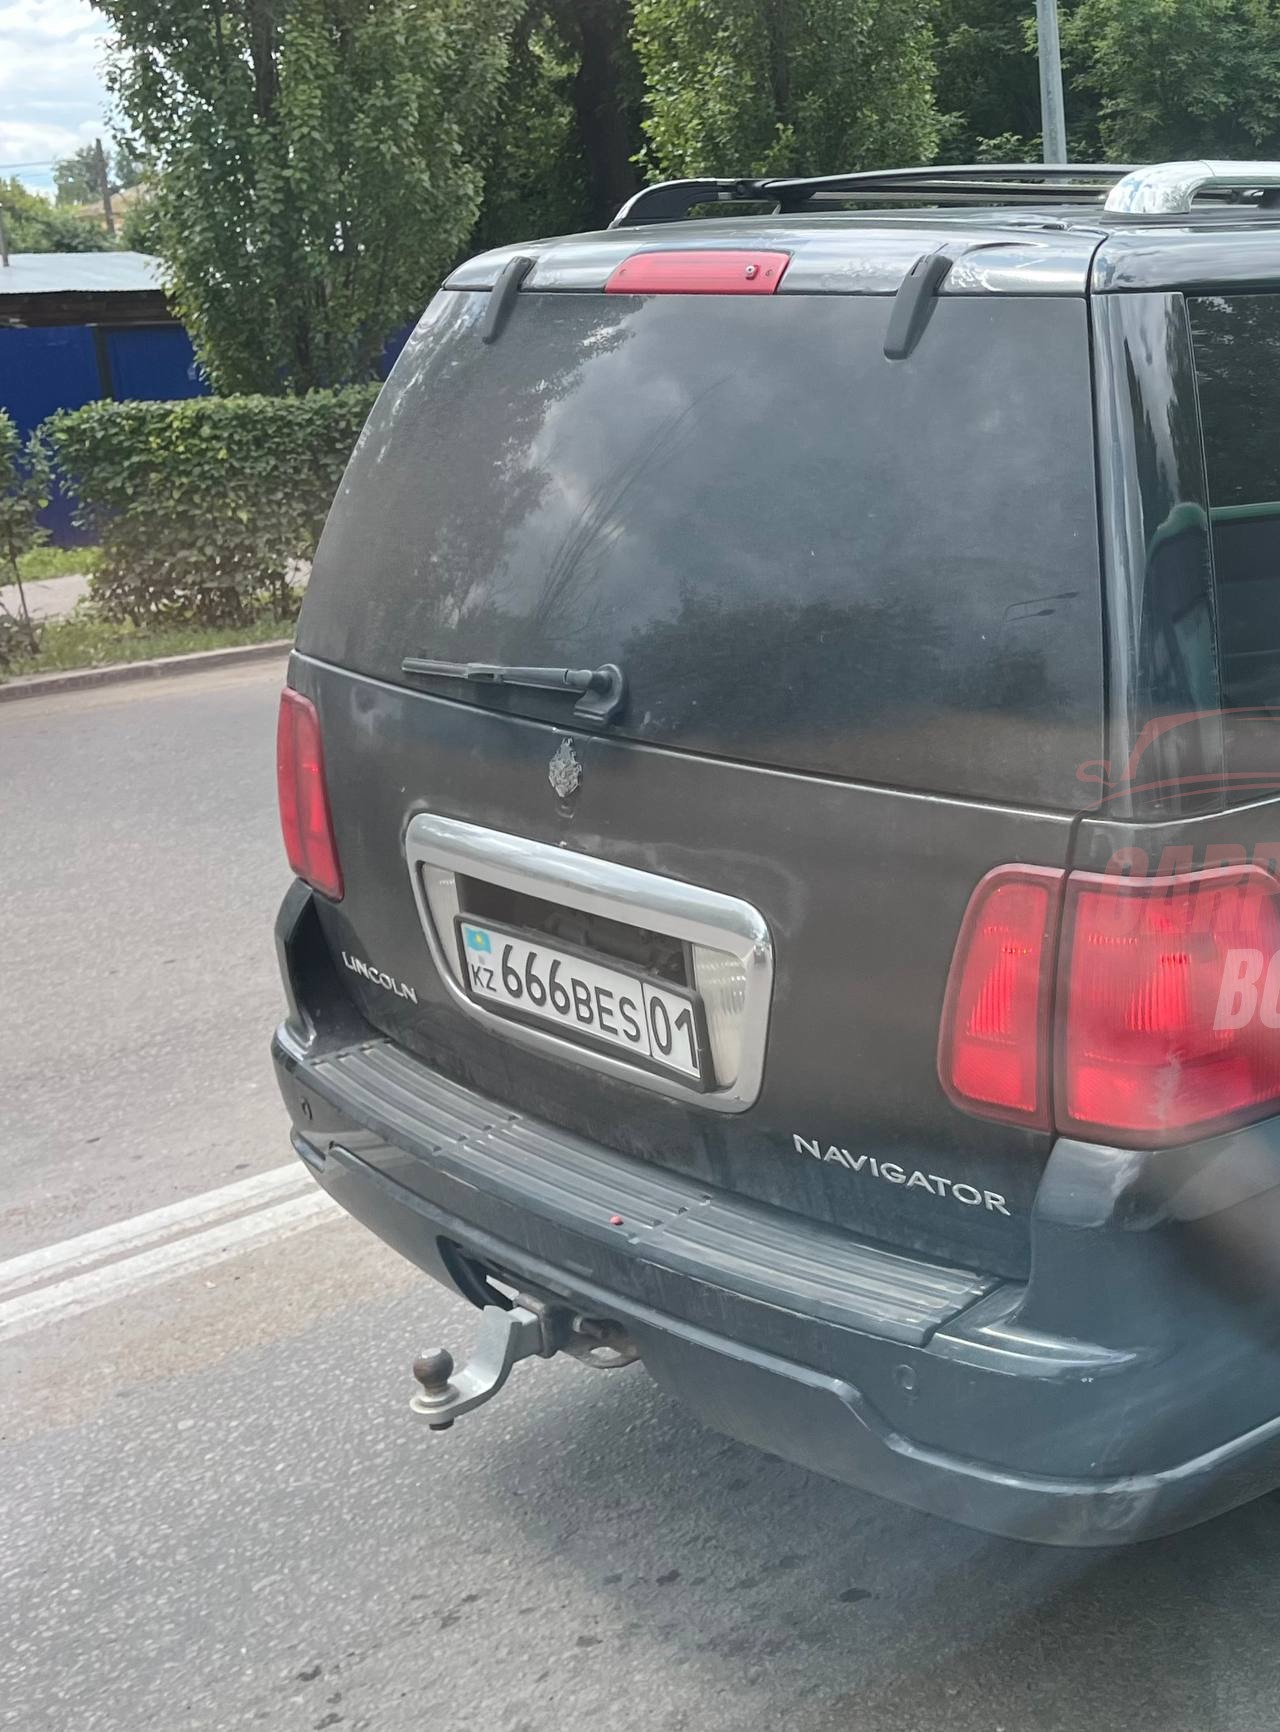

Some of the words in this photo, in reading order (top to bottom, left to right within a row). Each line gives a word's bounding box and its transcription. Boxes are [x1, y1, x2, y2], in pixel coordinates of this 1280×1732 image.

[342, 951, 418, 1004] LINCOLN
[471, 964, 497, 992] KZ
[793, 1134, 1012, 1217] NAVIGATOR
